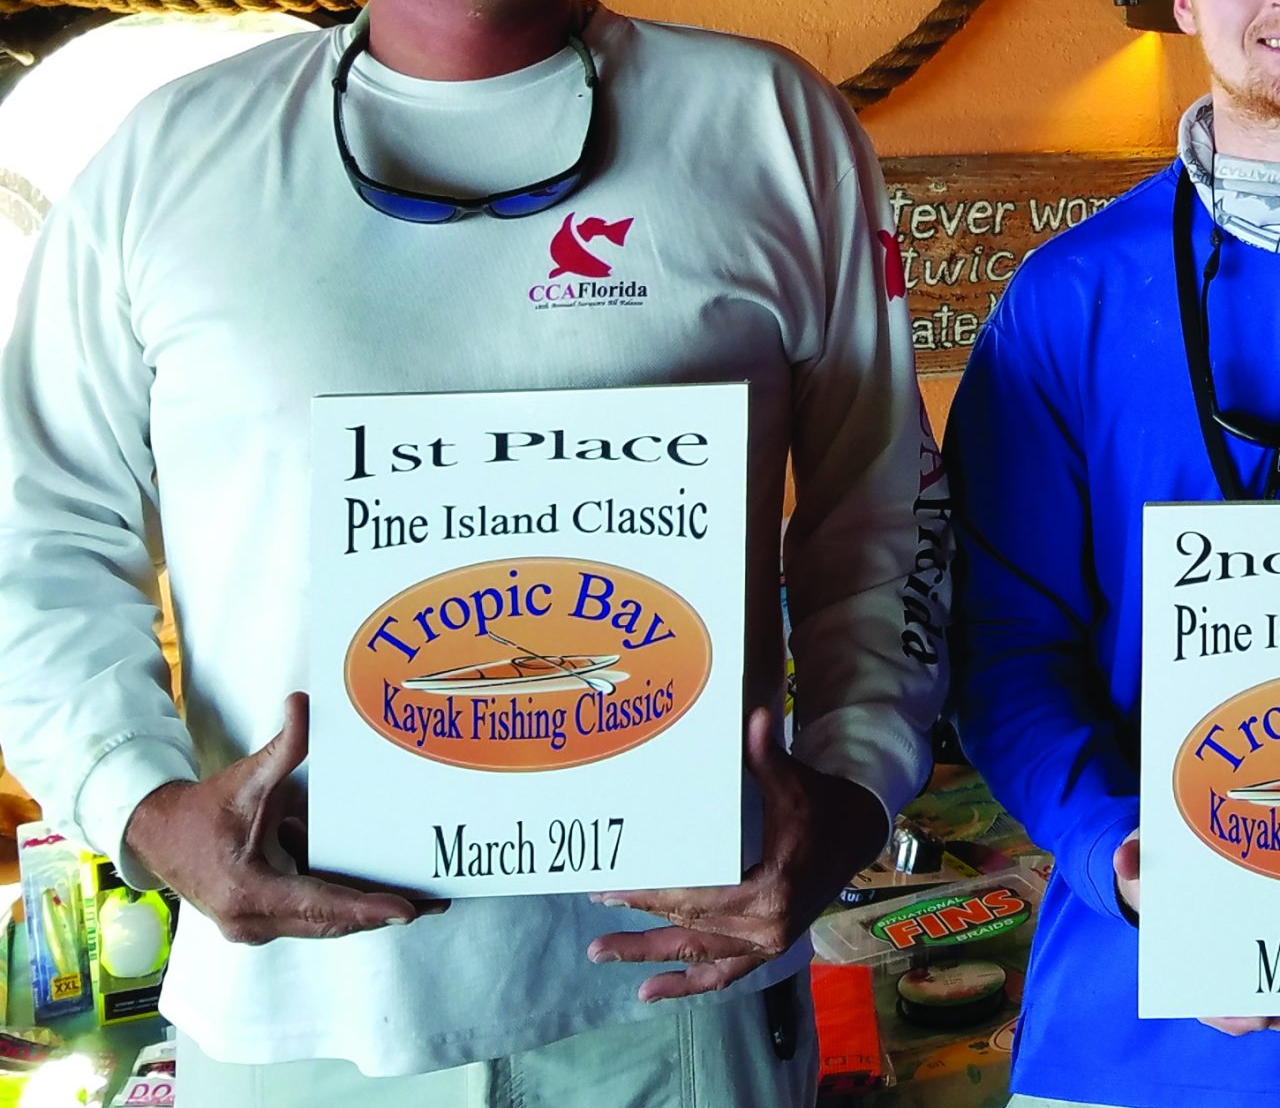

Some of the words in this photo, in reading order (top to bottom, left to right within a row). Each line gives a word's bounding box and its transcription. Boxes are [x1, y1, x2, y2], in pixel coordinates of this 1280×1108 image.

[902, 245, 1034, 289] twic
[343, 425, 459, 481] 1st
[484, 429, 710, 466] Place
[343, 497, 429, 555] Pine
[441, 503, 560, 541] Island
[572, 487, 708, 540] Classic
[367, 569, 553, 664] Tropic
[568, 572, 676, 650] Bay
[1174, 604, 1252, 661] Pine
[383, 678, 463, 747] Kayak
[470, 698, 567, 750] Fishing
[575, 680, 674, 736] Classics
[432, 820, 536, 879] March
[548, 818, 625, 873] 2017
[877, 896, 964, 928] SITUATIONAL
[883, 889, 1025, 950] FINS
[956, 918, 1014, 942] BRAIDS
[55, 979, 80, 994] XXL
